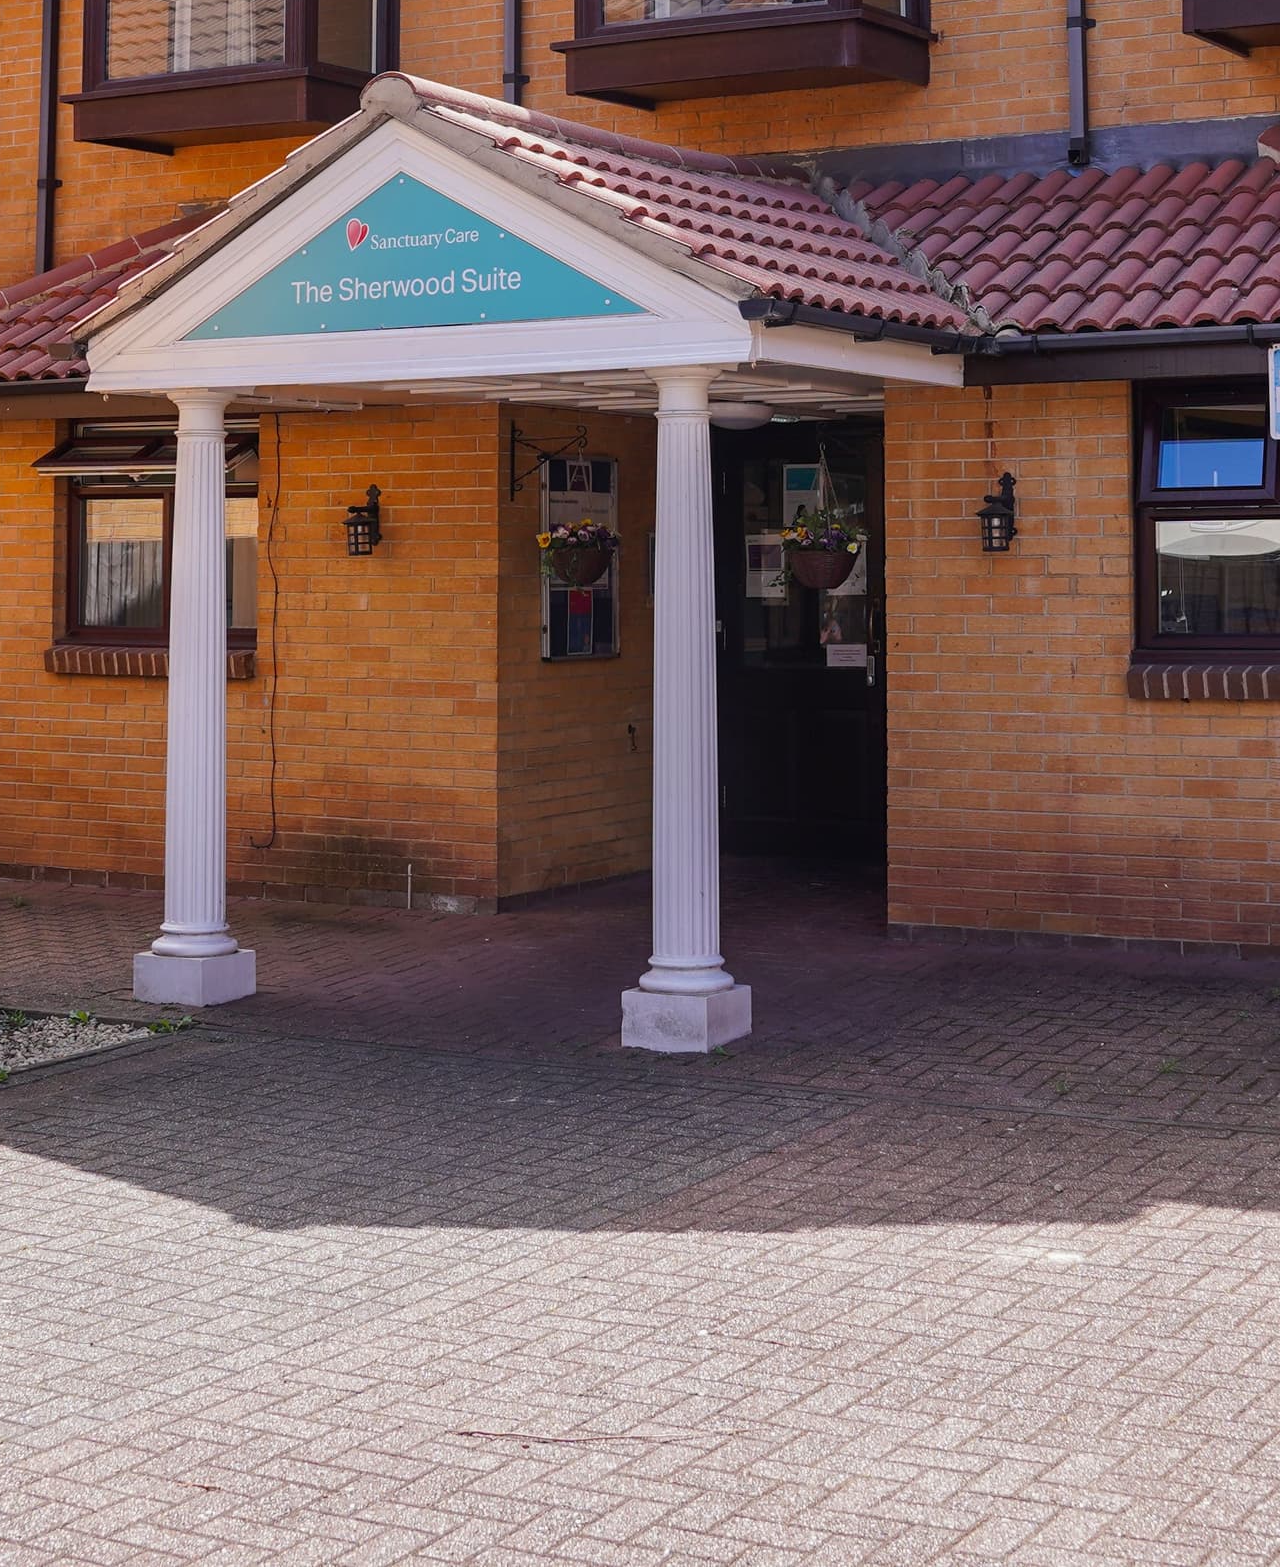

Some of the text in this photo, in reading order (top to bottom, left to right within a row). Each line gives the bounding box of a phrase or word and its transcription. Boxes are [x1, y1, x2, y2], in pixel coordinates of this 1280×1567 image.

[370, 228, 480, 250] Sanctuary Care
[291, 267, 521, 304] The Sherwood Suite
